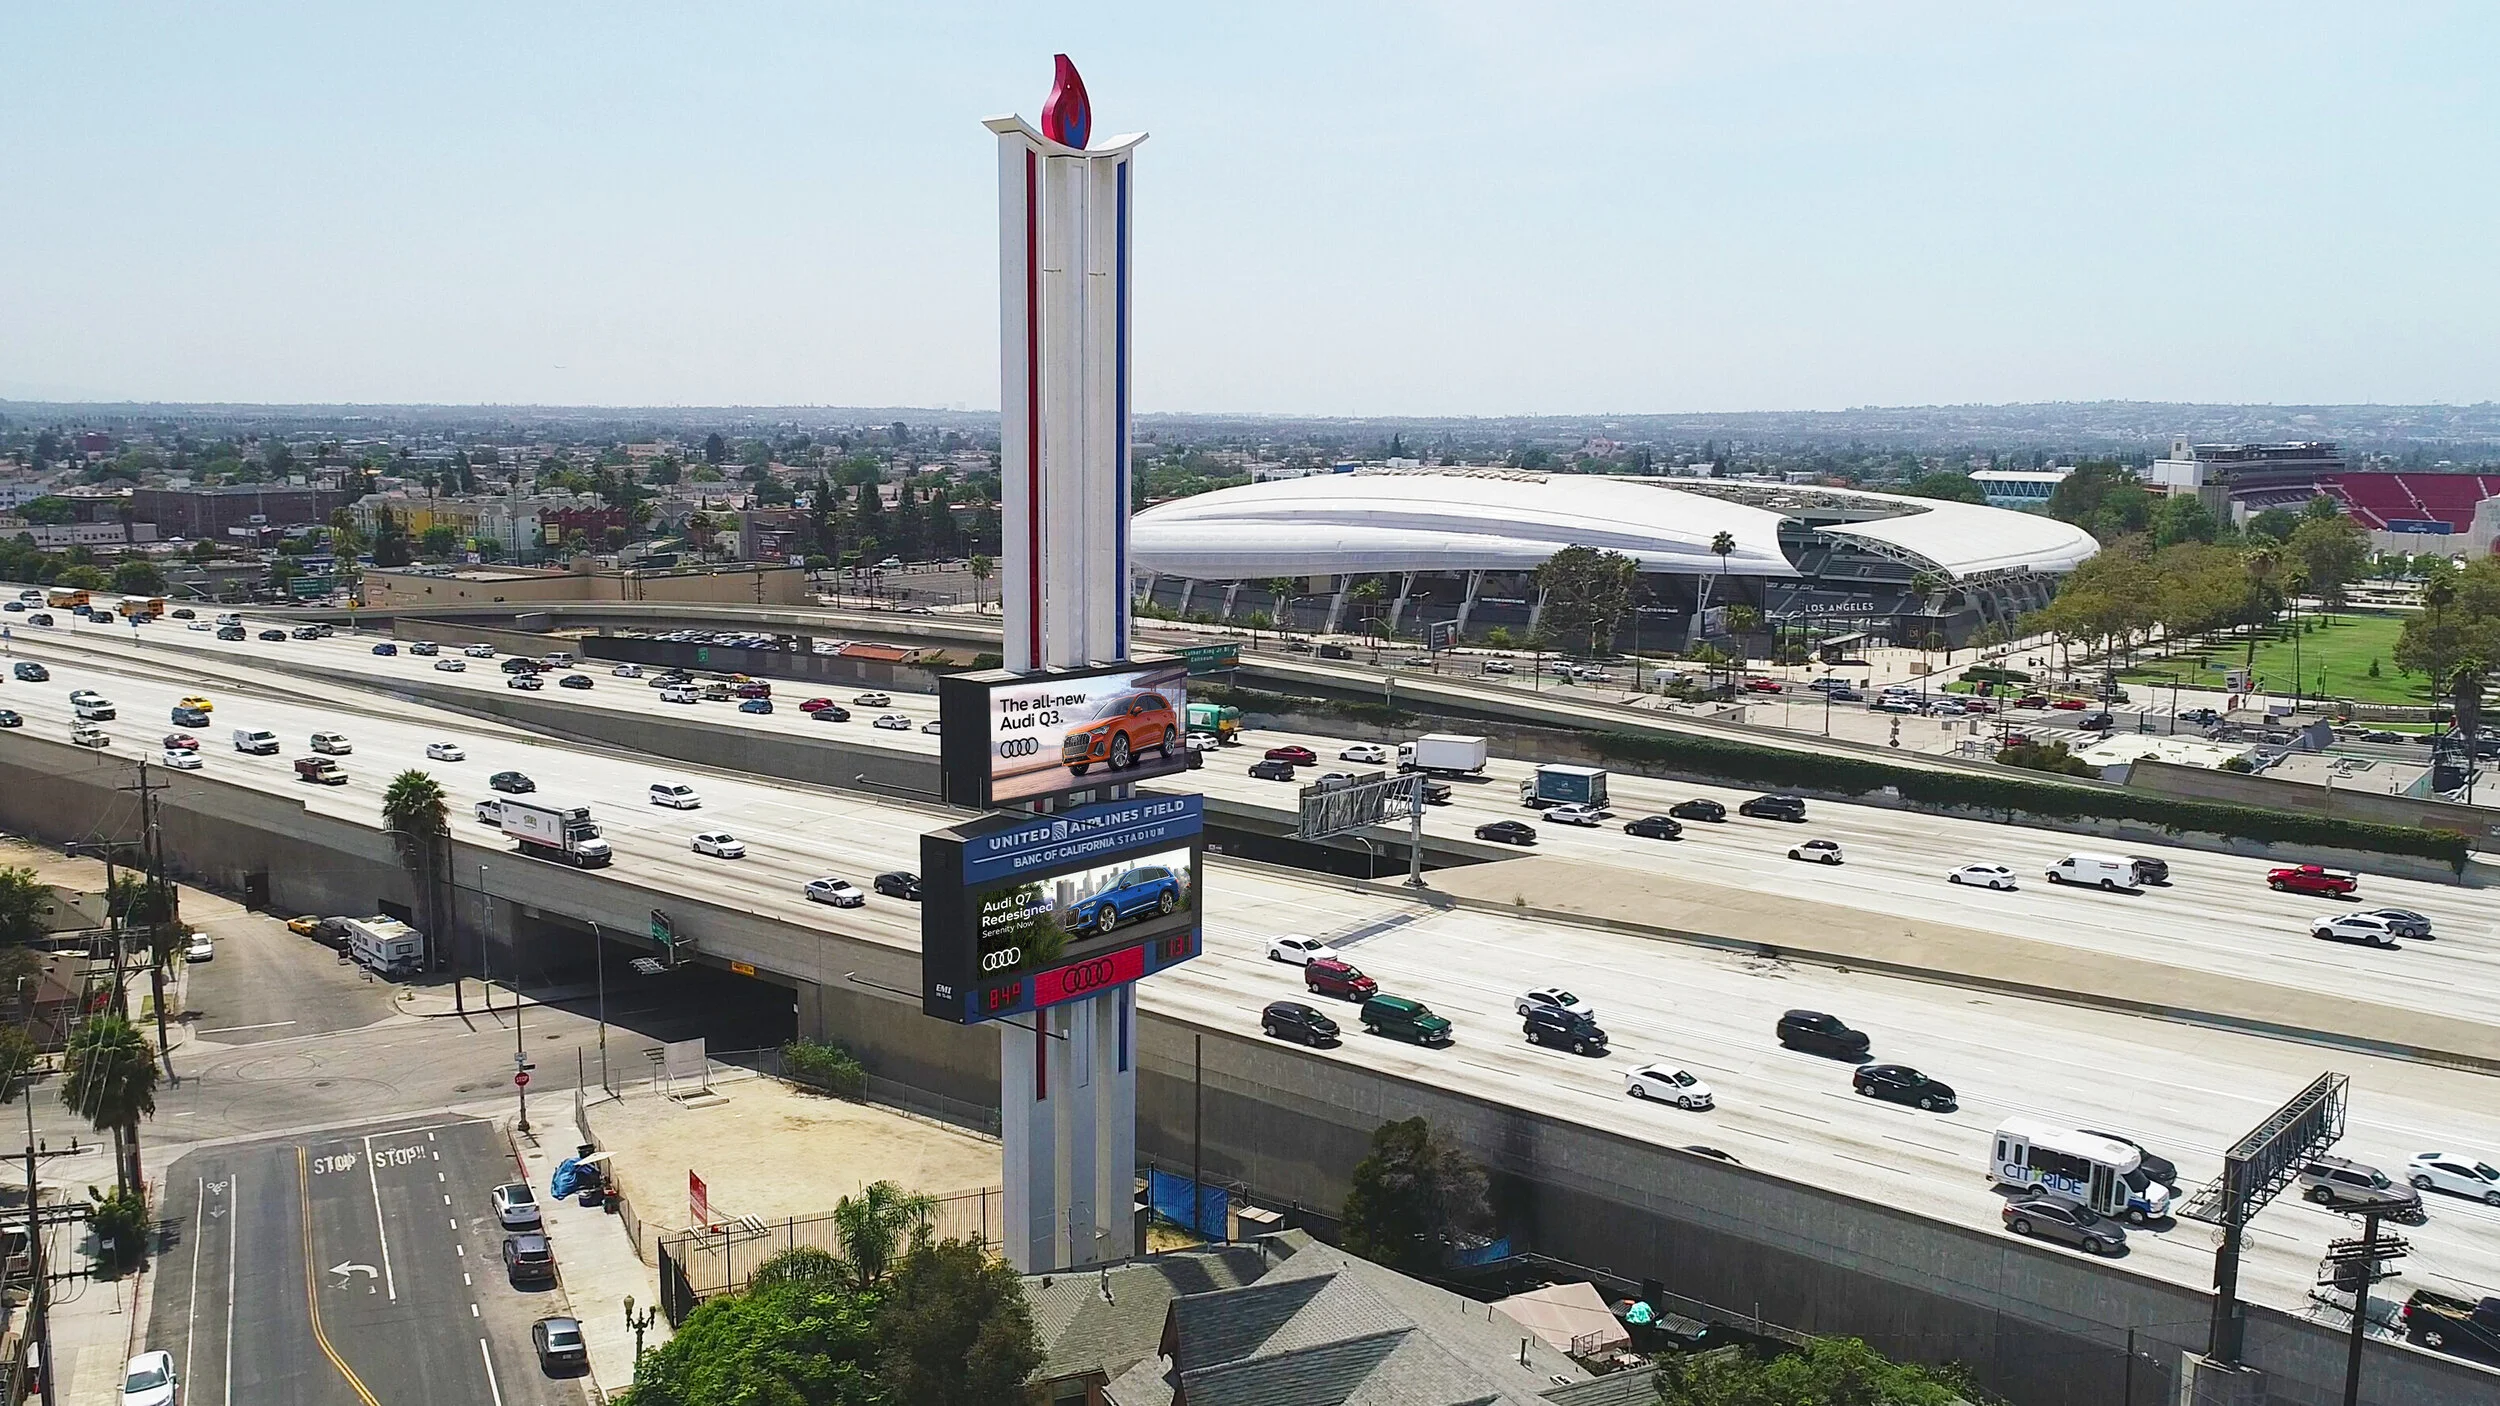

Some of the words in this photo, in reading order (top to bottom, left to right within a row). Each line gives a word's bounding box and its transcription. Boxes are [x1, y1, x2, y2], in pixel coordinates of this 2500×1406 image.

[1805, 603, 1824, 613] LOS
[1828, 602, 1874, 611] ANGELES
[1000, 699, 1028, 713] The
[1033, 693, 1086, 710] all-new
[1000, 713, 1035, 731] Audi
[1040, 710, 1064, 727] Q3.
[989, 828, 1050, 850] UNITED
[1069, 809, 1139, 833] AIRLINES
[1144, 800, 1184, 818] FIELD
[1013, 853, 1042, 868] BANC
[1043, 849, 1058, 861] OF
[1059, 837, 1115, 857] CALIFORNIA
[1117, 827, 1165, 845] STADIUM
[983, 897, 1012, 914] Audi
[1015, 892, 1032, 906] Q7
[982, 900, 1053, 928] Redesigned
[982, 925, 1015, 939] Serenity
[1016, 919, 1035, 929] Now
[936, 983, 953, 995] EMI
[516, 1075, 528, 1083] STOP
